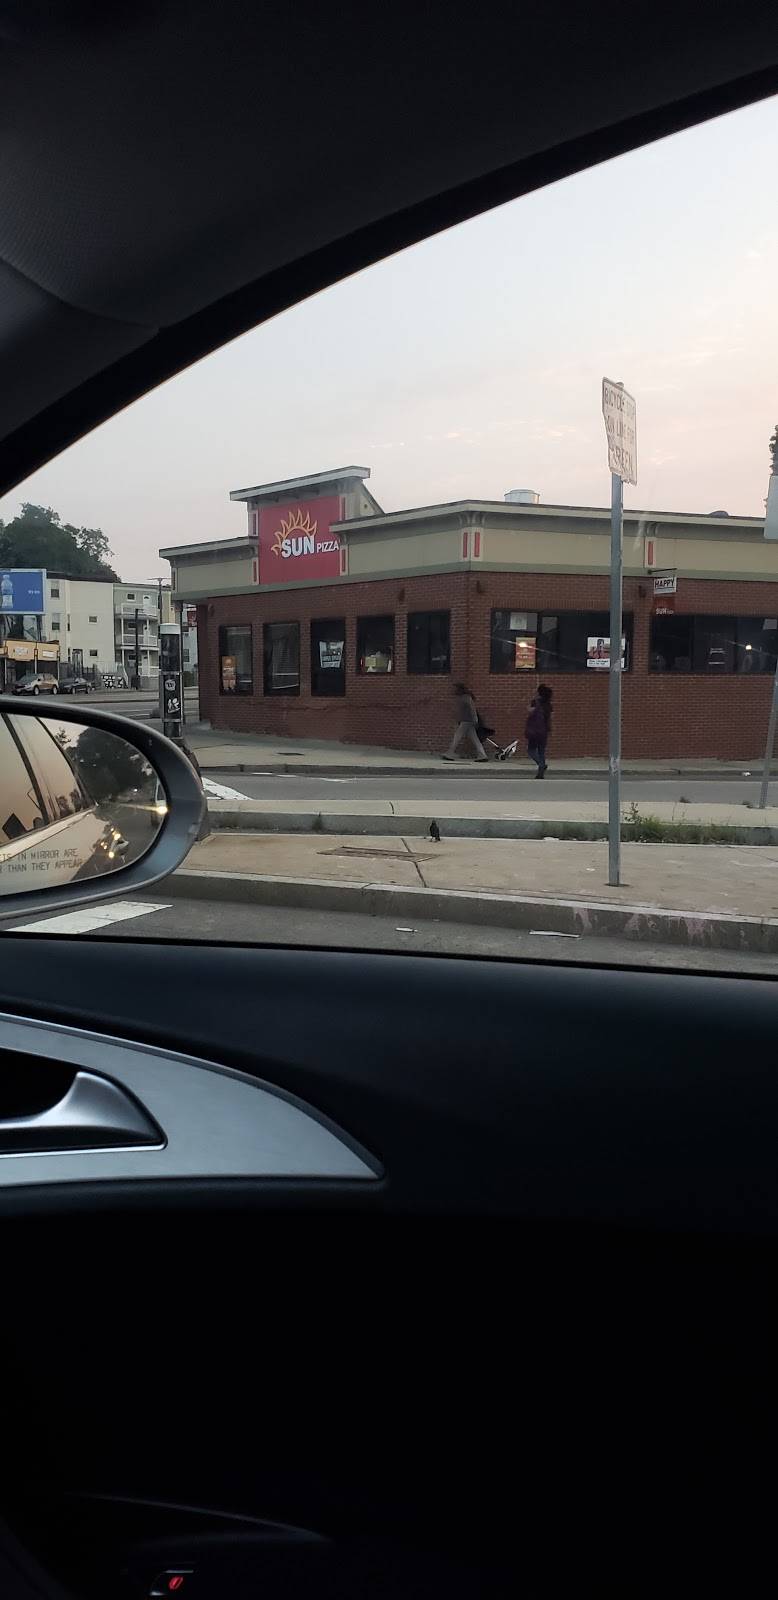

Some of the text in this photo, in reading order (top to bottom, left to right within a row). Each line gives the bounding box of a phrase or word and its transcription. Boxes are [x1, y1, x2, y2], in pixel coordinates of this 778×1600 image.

[281, 535, 339, 558] SUN PIZZA
[655, 579, 674, 588] HAPPY
[31, 850, 59, 859] MIRROR
[64, 848, 78, 857] ARE
[8, 864, 27, 872] THAN
[32, 862, 50, 870] THEY
[55, 860, 82, 869] APPEAR
